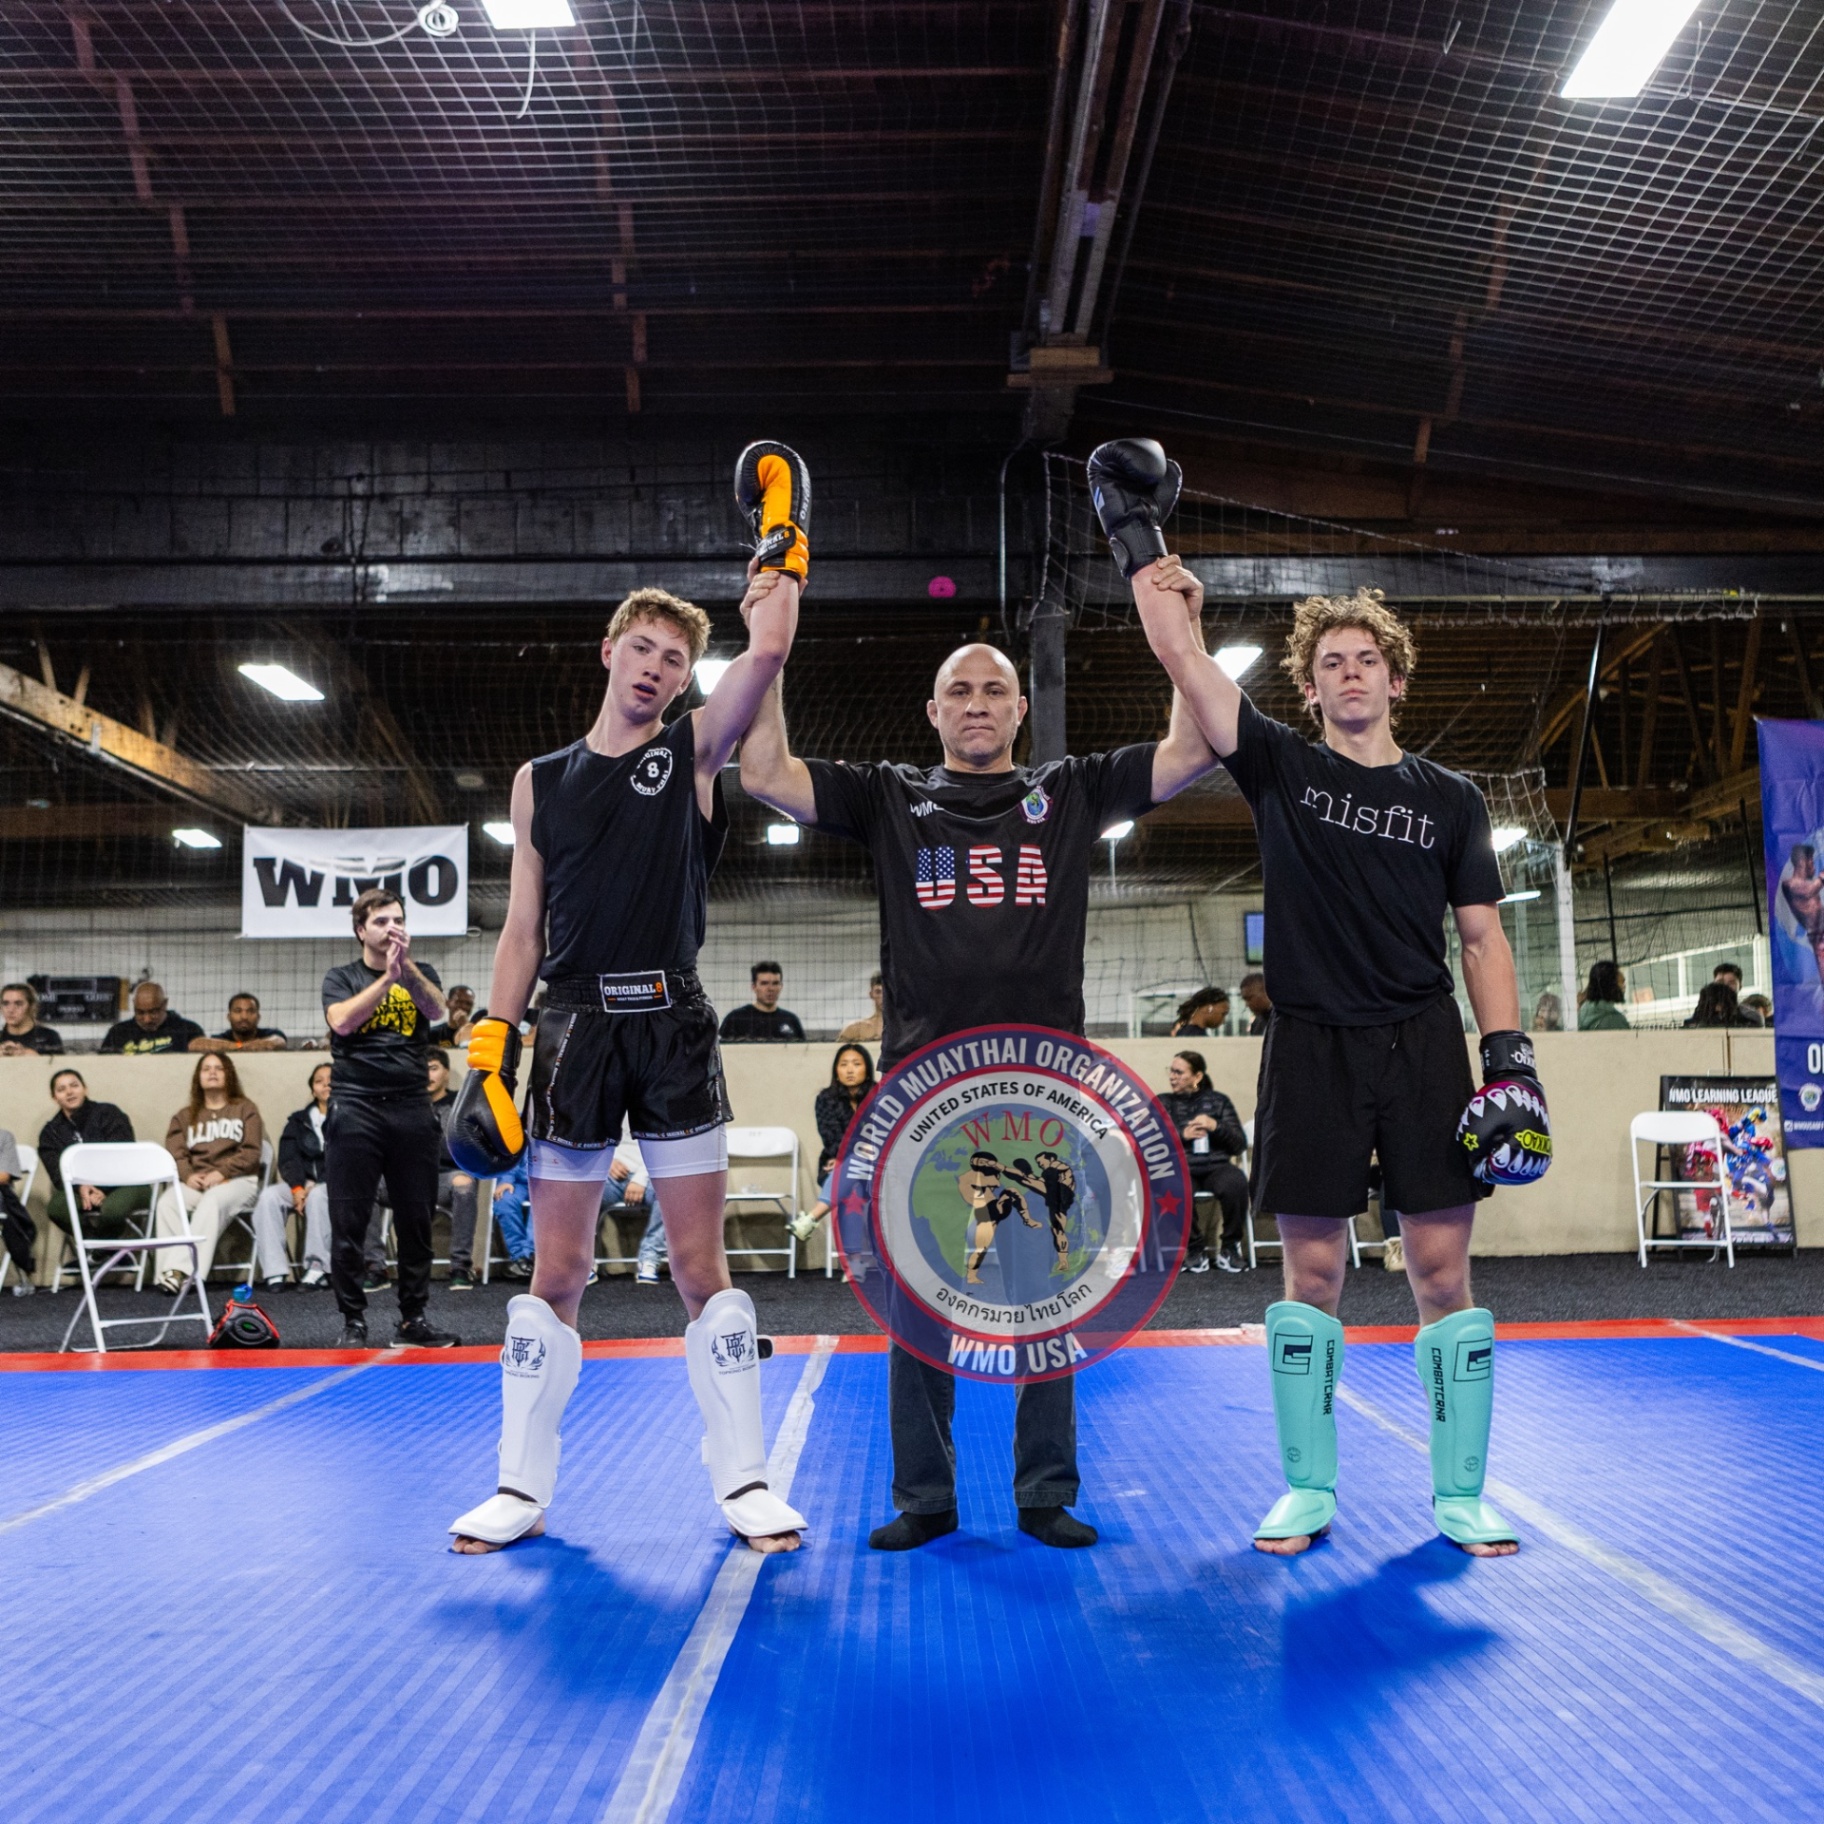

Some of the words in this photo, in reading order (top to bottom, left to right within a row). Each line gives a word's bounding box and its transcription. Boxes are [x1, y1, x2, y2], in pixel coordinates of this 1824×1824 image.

[647, 762, 660, 778] 8
[1300, 786, 1436, 849] misfit
[253, 855, 459, 908] WMO
[915, 843, 1048, 911] USA
[604, 981, 664, 996] ORIGINAL8
[1807, 1043, 1824, 1074] O
[1323, 1339, 1335, 1416] COMBATCRNR
[1431, 1347, 1446, 1423] COMBATCRNR
